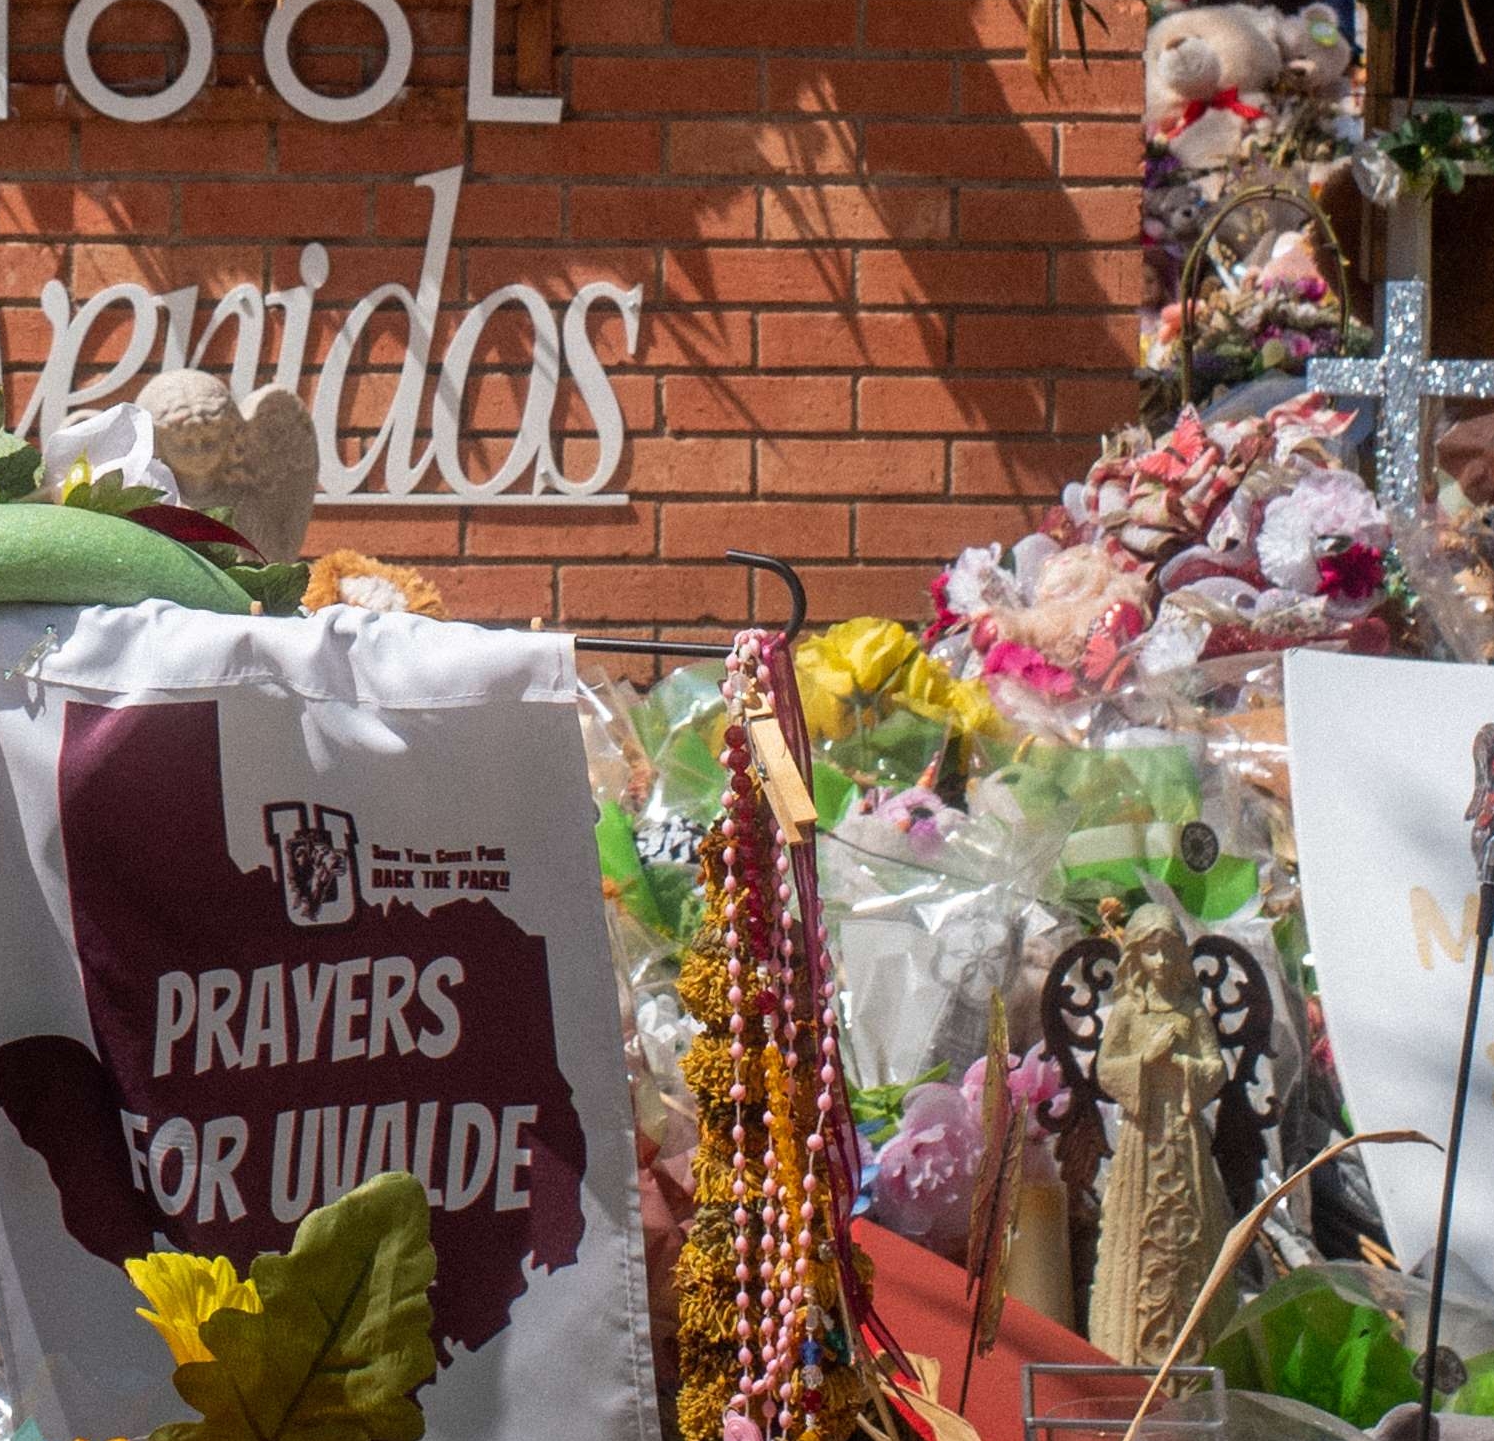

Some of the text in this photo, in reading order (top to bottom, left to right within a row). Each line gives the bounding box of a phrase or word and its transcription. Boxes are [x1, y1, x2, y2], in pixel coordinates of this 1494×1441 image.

[371, 867, 415, 889] BACK
[421, 869, 451, 889] THE
[152, 955, 465, 1078] PRAYERS
[119, 1101, 539, 1225] FOR UVALDE
